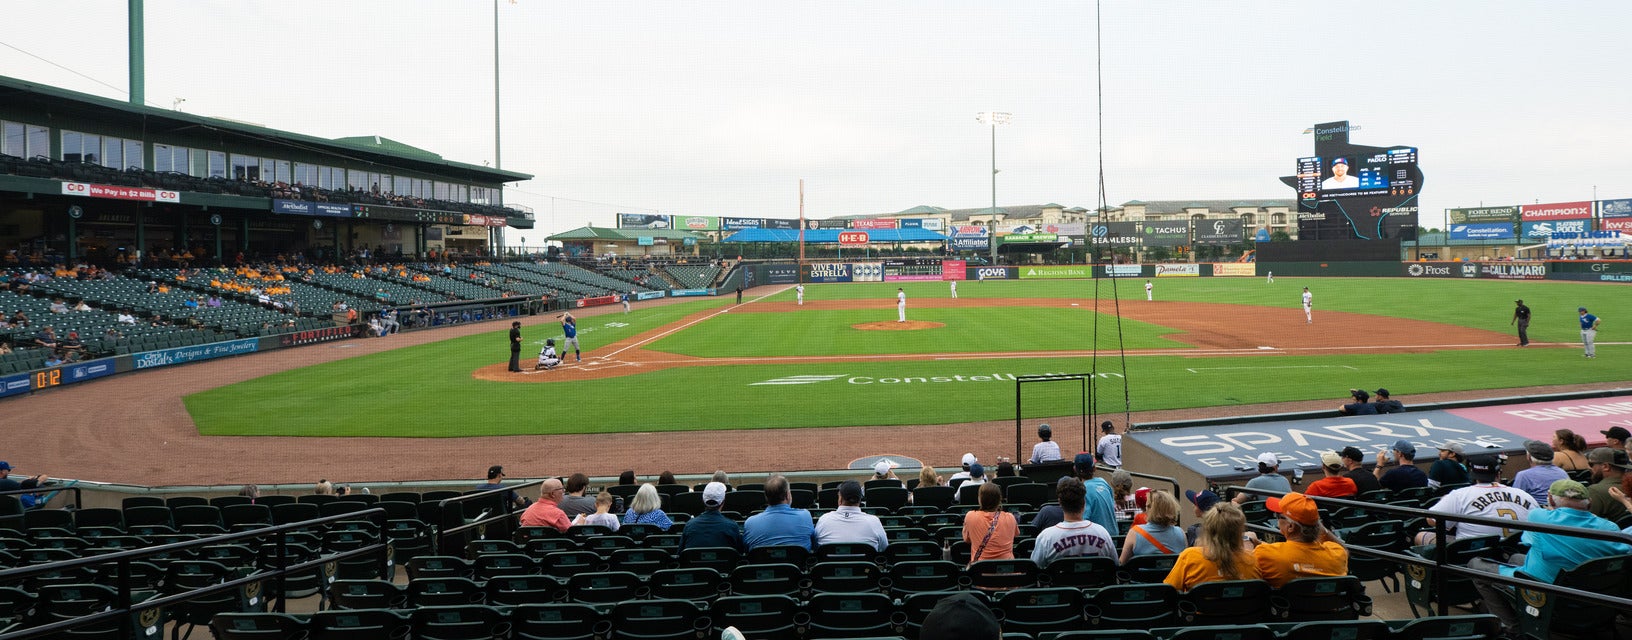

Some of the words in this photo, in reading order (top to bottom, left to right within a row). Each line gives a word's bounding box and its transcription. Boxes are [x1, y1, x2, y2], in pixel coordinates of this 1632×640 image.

[1316, 125, 1361, 135] Constellation
[1606, 220, 1624, 229] kw
[1581, 230, 1622, 238] LIGHT
[958, 238, 988, 246] Affiliated
[978, 268, 1006, 276] GOYA
[1425, 266, 1450, 274] Frost
[1490, 265, 1508, 275] CALL
[1509, 265, 1546, 276] AMARO
[292, 326, 351, 340] FORTIFIED
[137, 352, 172, 368] Dostal's
[175, 350, 202, 360] Designs
[848, 372, 1125, 385] Constelln
[1159, 418, 1474, 456] SPARX
[1472, 492, 1532, 511] BREGMAN
[1053, 534, 1106, 553] ALTUVE
